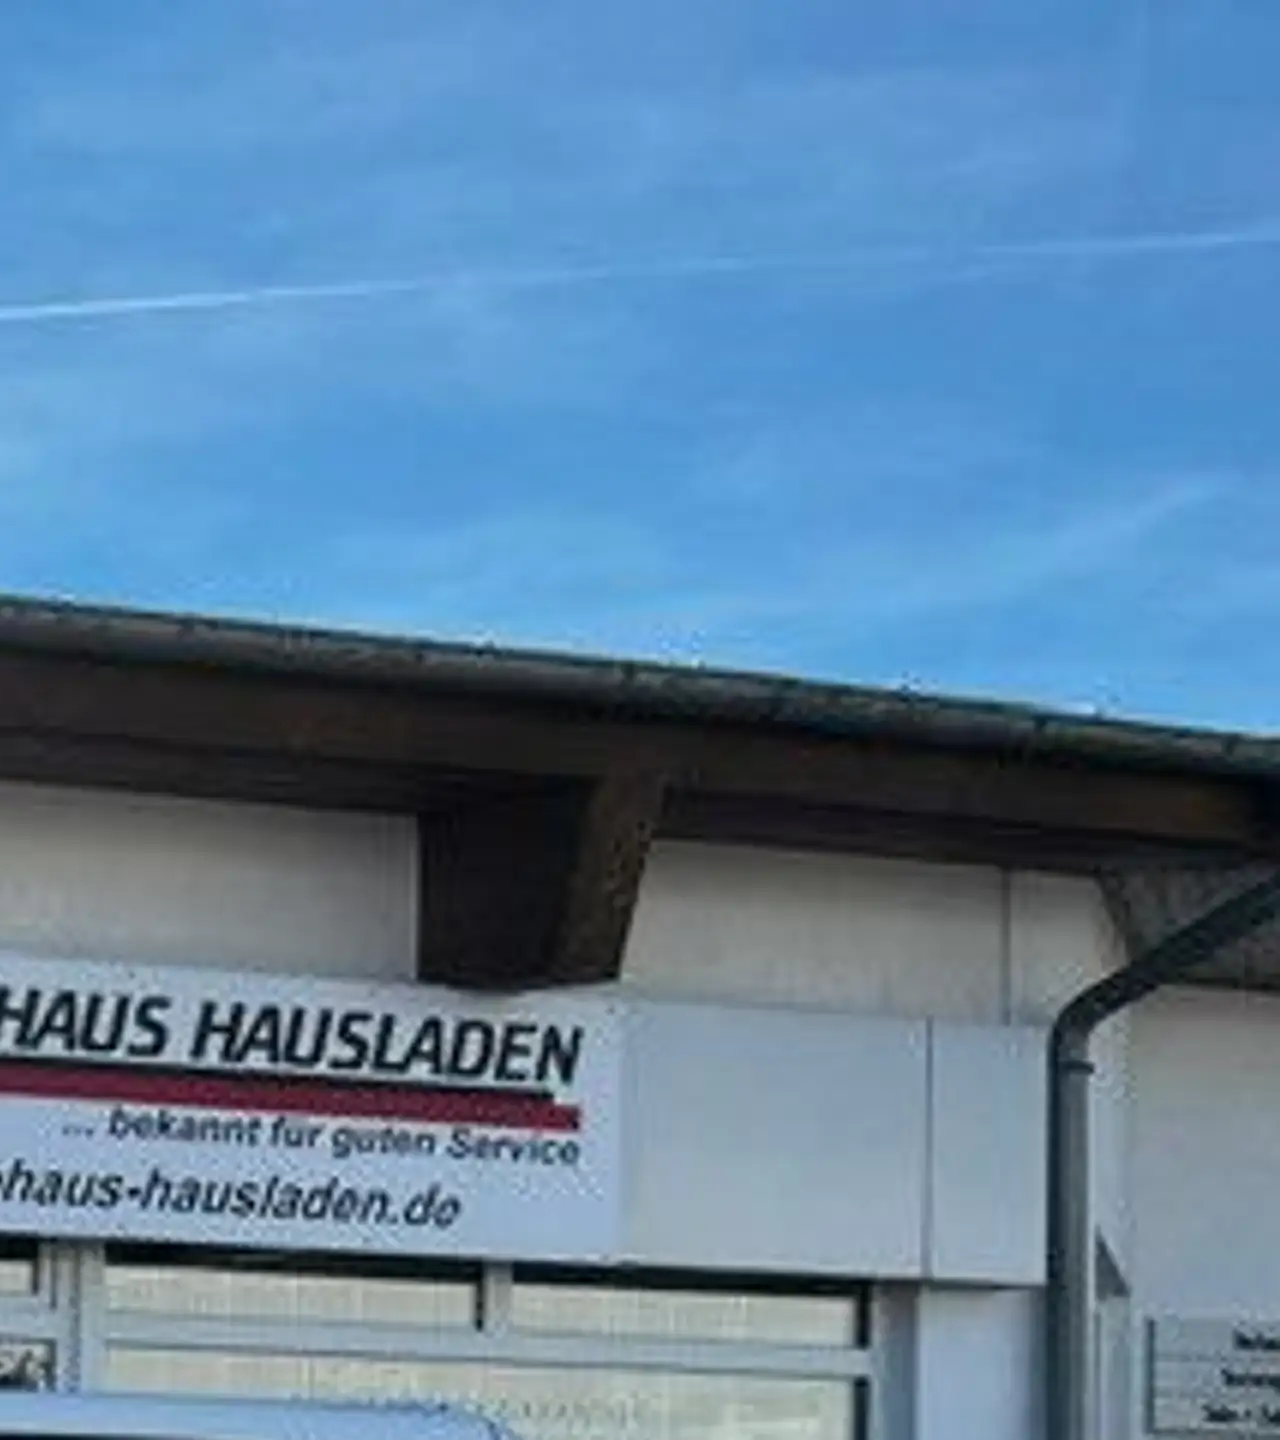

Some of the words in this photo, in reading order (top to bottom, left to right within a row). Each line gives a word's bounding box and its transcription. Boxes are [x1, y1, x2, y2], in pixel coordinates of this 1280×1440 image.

[188, 998, 585, 1086] HAUSLADEN
[108, 1103, 262, 1149] bekannt
[332, 1126, 436, 1160] guten
[446, 1126, 581, 1167] Service
